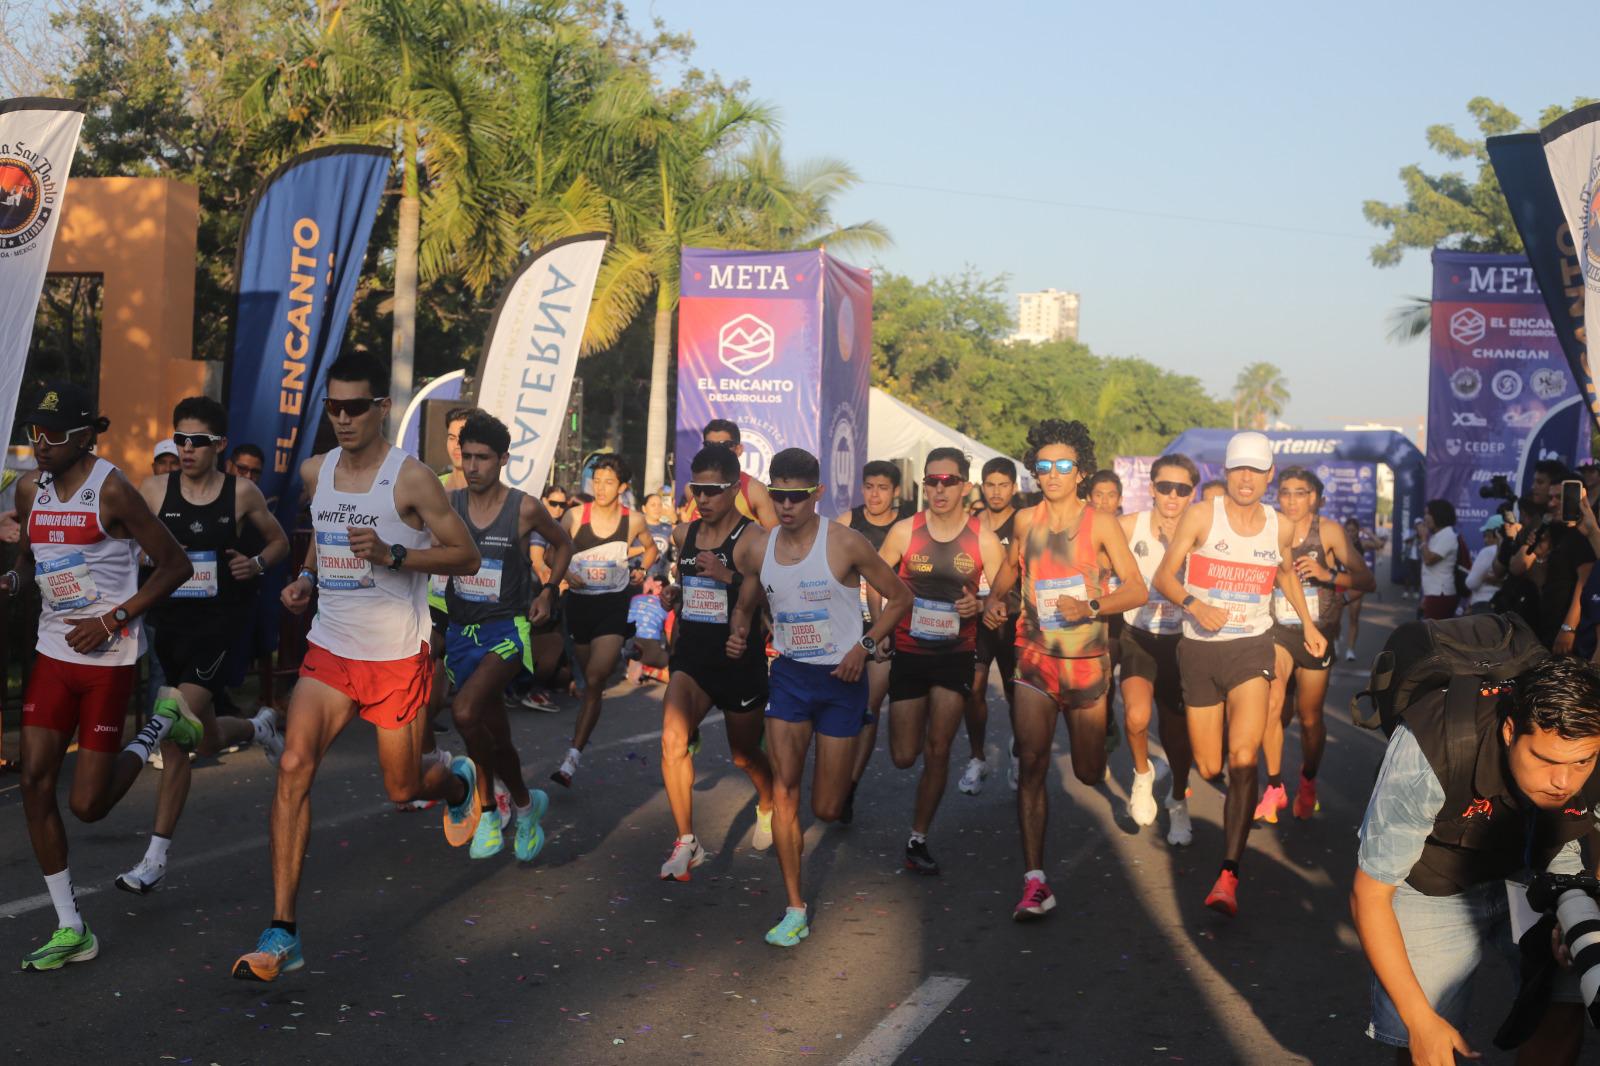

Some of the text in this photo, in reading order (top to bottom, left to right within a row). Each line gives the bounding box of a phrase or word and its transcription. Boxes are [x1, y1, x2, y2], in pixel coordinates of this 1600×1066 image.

[13, 141, 39, 165] San
[33, 157, 58, 204] Pablo
[708, 265, 790, 290] META
[1468, 266, 1542, 294] MET
[1490, 317, 1506, 329] EL
[273, 217, 321, 474] EL ENCANTO
[1472, 348, 1549, 360] CHANGAN
[698, 378, 794, 393] EL ENCANTO
[708, 393, 782, 404] DESARROLLOS
[1464, 441, 1506, 454] CEDEP
[338, 503, 357, 512] TEAM
[317, 510, 379, 527] WHITE ROCK
[48, 530, 65, 543] CLUB
[48, 571, 75, 587] ULISES
[51, 582, 81, 597] ADRIAN
[692, 589, 715, 600] JESUS
[791, 624, 816, 635] DIEGO
[791, 634, 822, 646] ADOLFO
